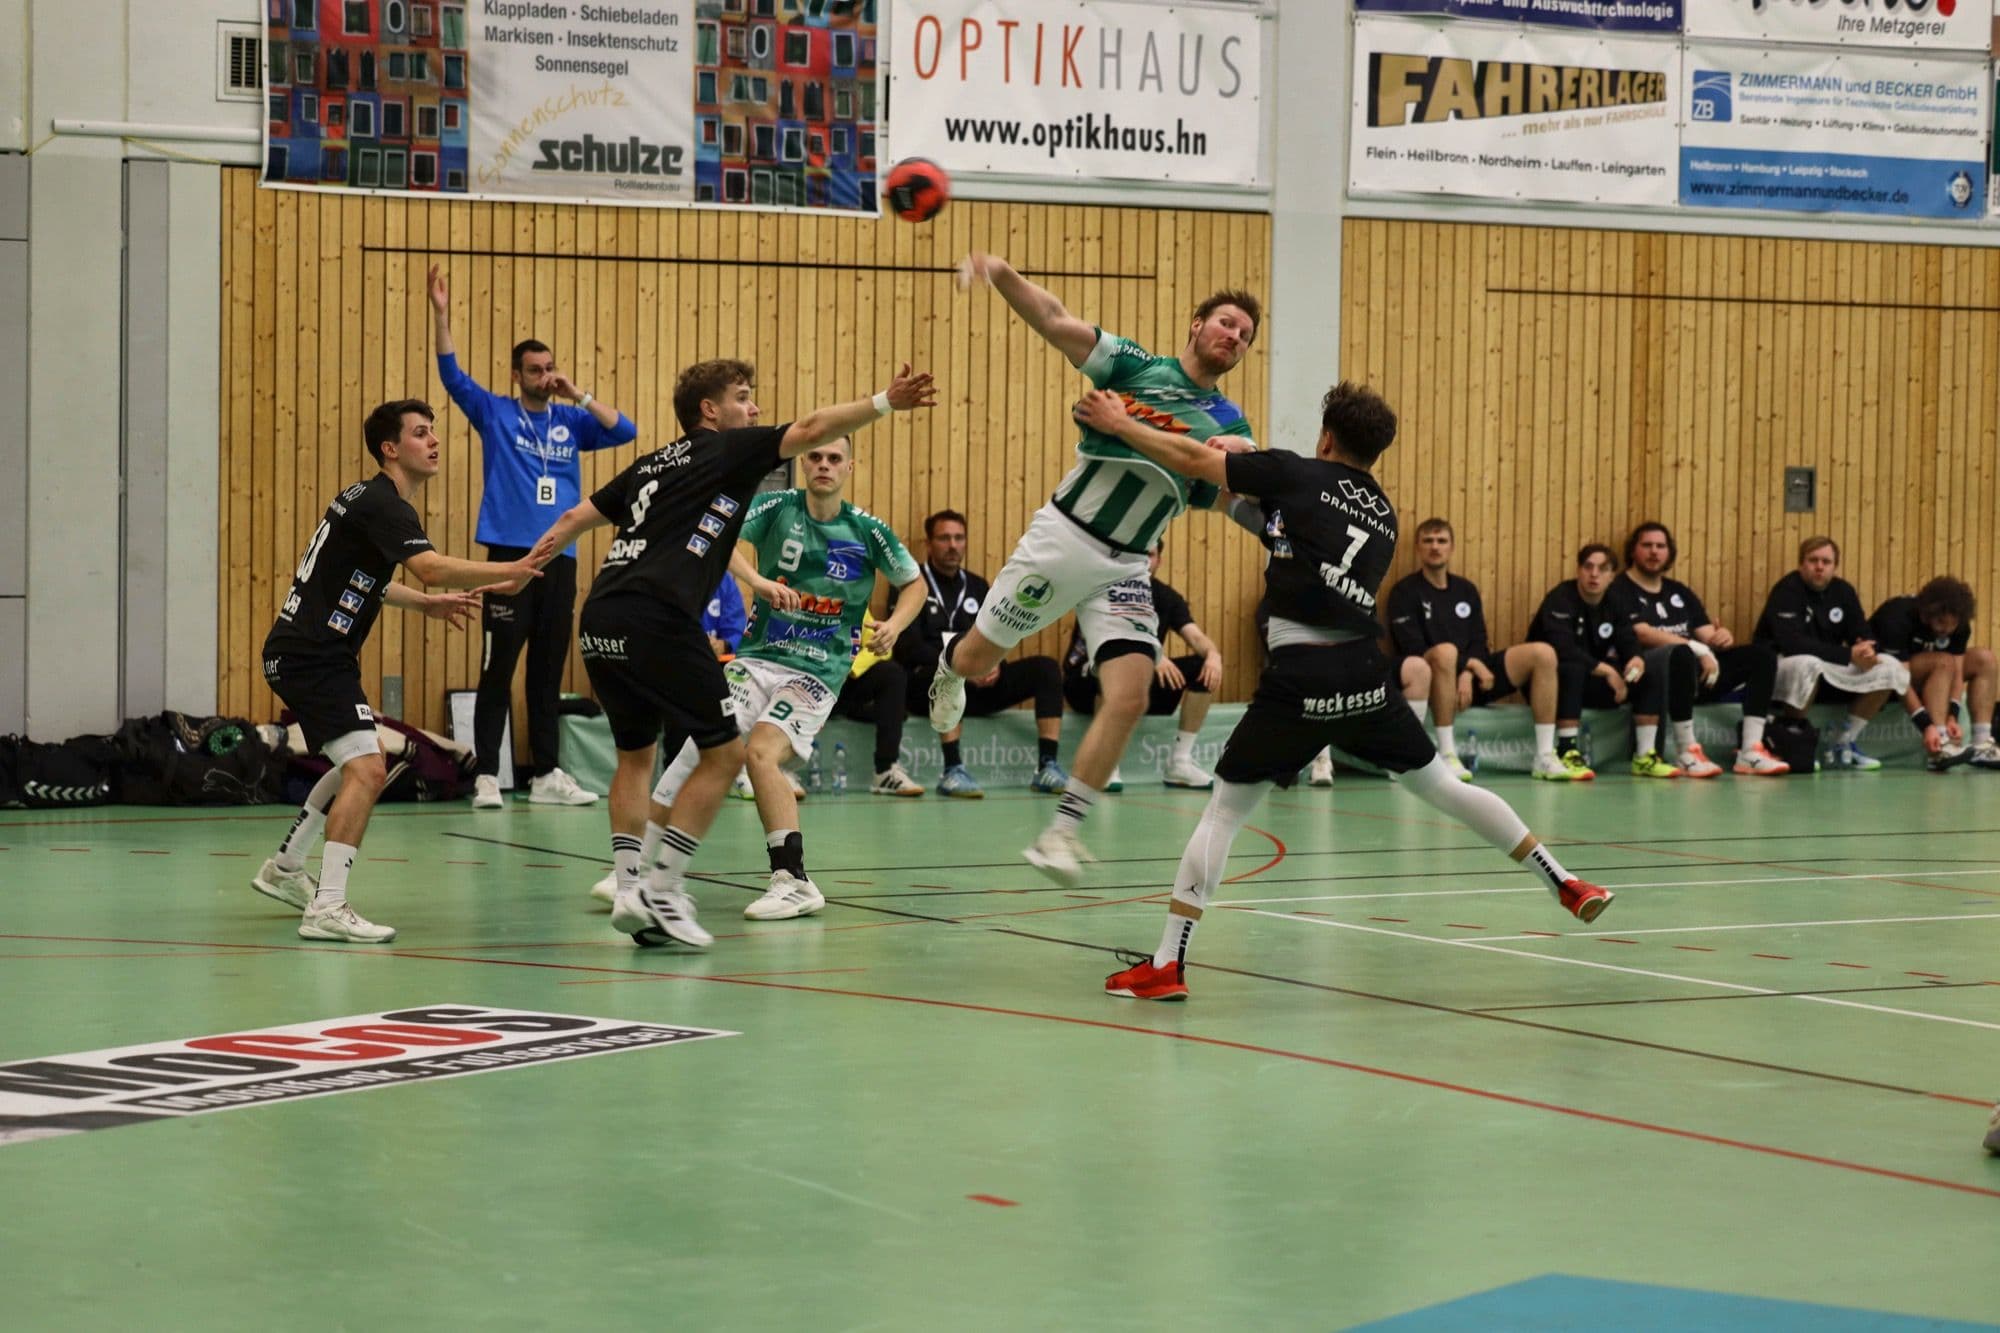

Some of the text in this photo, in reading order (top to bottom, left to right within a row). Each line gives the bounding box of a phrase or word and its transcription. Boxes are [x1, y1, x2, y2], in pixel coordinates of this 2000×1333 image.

[484, 0, 678, 25] Klappladen Schiebeladen
[1532, 0, 1673, 21] Auswuchttechnologie
[484, 26, 678, 52] Markisen Insektenschutz
[1837, 16, 1947, 38] Ihre Metzgerei
[535, 55, 628, 78] Sonnensegel
[914, 15, 1241, 98] OPTIKHAUS
[1367, 52, 1667, 128] FAHRERLAGER
[1739, 72, 1977, 100] ZIMMERMANN und BECKER GmbH
[1522, 119, 1560, 136] mehr
[1563, 117, 1581, 129] als
[1584, 116, 1602, 126] nur
[1605, 106, 1667, 125] FAHRSCHULE
[1693, 100, 1714, 119] ZB
[945, 113, 1207, 157] www.optikhaus.hn
[532, 134, 683, 175] schulze
[1366, 147, 1666, 178] Flein Heilbronn Nordheim Lauffen Leingarten
[1690, 181, 1909, 204] www.zimmermannundbecker.de
[541, 486, 552, 500] B
[1321, 491, 1395, 542] DRAHTMAYR
[777, 538, 804, 572] 9
[1340, 523, 1370, 574] 7
[826, 561, 848, 579] ZB
[769, 700, 793, 721] 9
